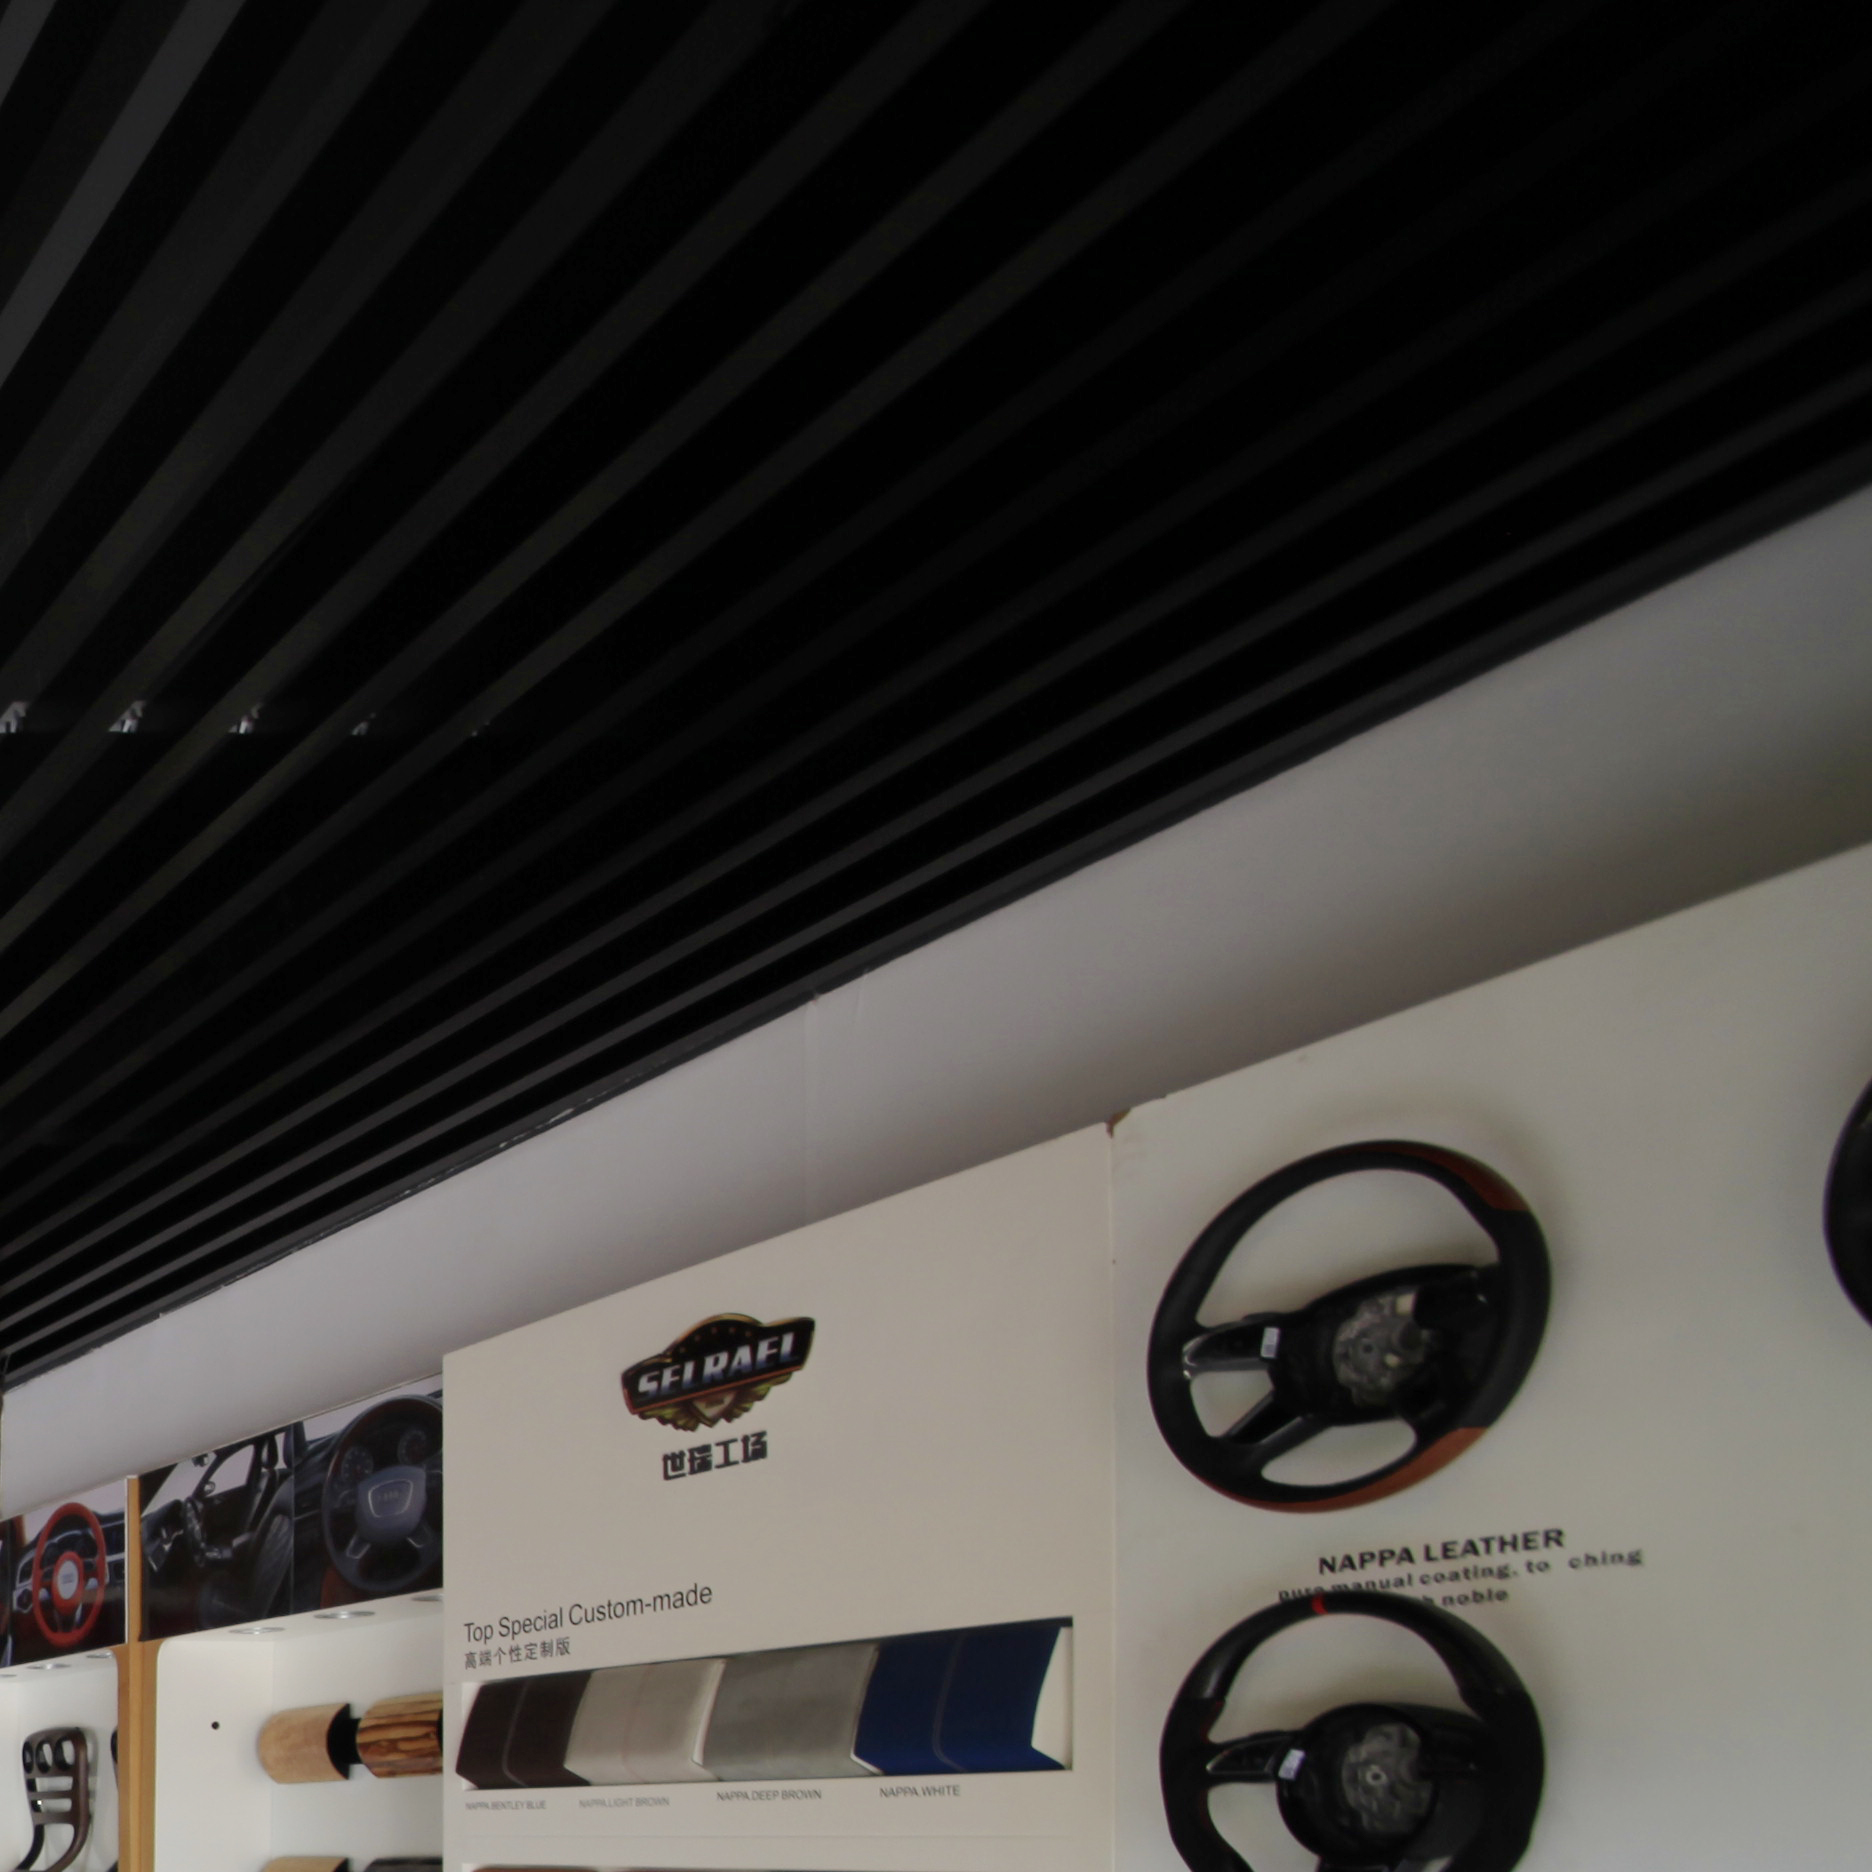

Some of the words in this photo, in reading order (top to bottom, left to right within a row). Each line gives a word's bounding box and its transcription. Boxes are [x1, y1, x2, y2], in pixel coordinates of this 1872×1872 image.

[1318, 1544, 1416, 1576] NAPPA
[1423, 1528, 1566, 1563] LEATHER
[464, 1622, 494, 1645] Top
[498, 1607, 564, 1640] Special
[568, 1583, 713, 1627] Custom-made
[464, 1637, 571, 1671] 高端个性定制版
